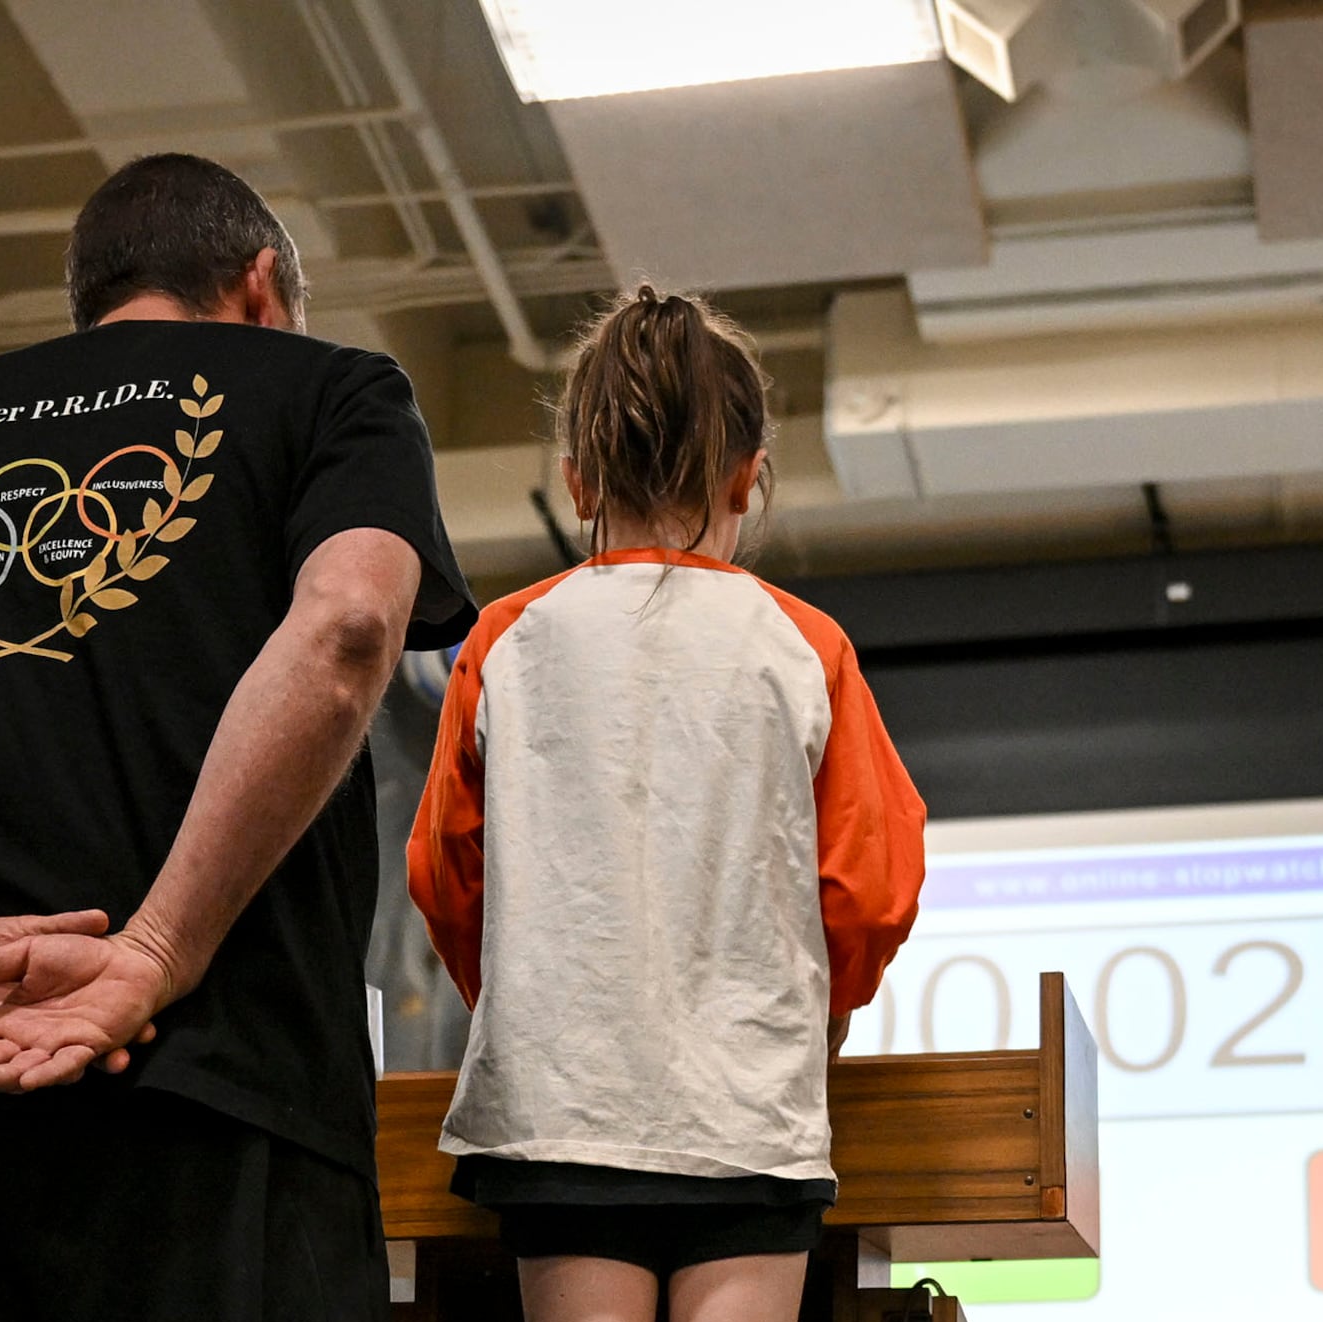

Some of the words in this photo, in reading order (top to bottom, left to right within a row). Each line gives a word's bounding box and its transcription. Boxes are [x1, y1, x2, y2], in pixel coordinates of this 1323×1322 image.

[30, 380, 175, 420] P.R.I.D.E.
[92, 480, 164, 491] INCLUSIVENESS
[0, 487, 47, 502] RESPECT
[38, 538, 93, 555] EXCELLENCE
[50, 549, 86, 562] EQUITY
